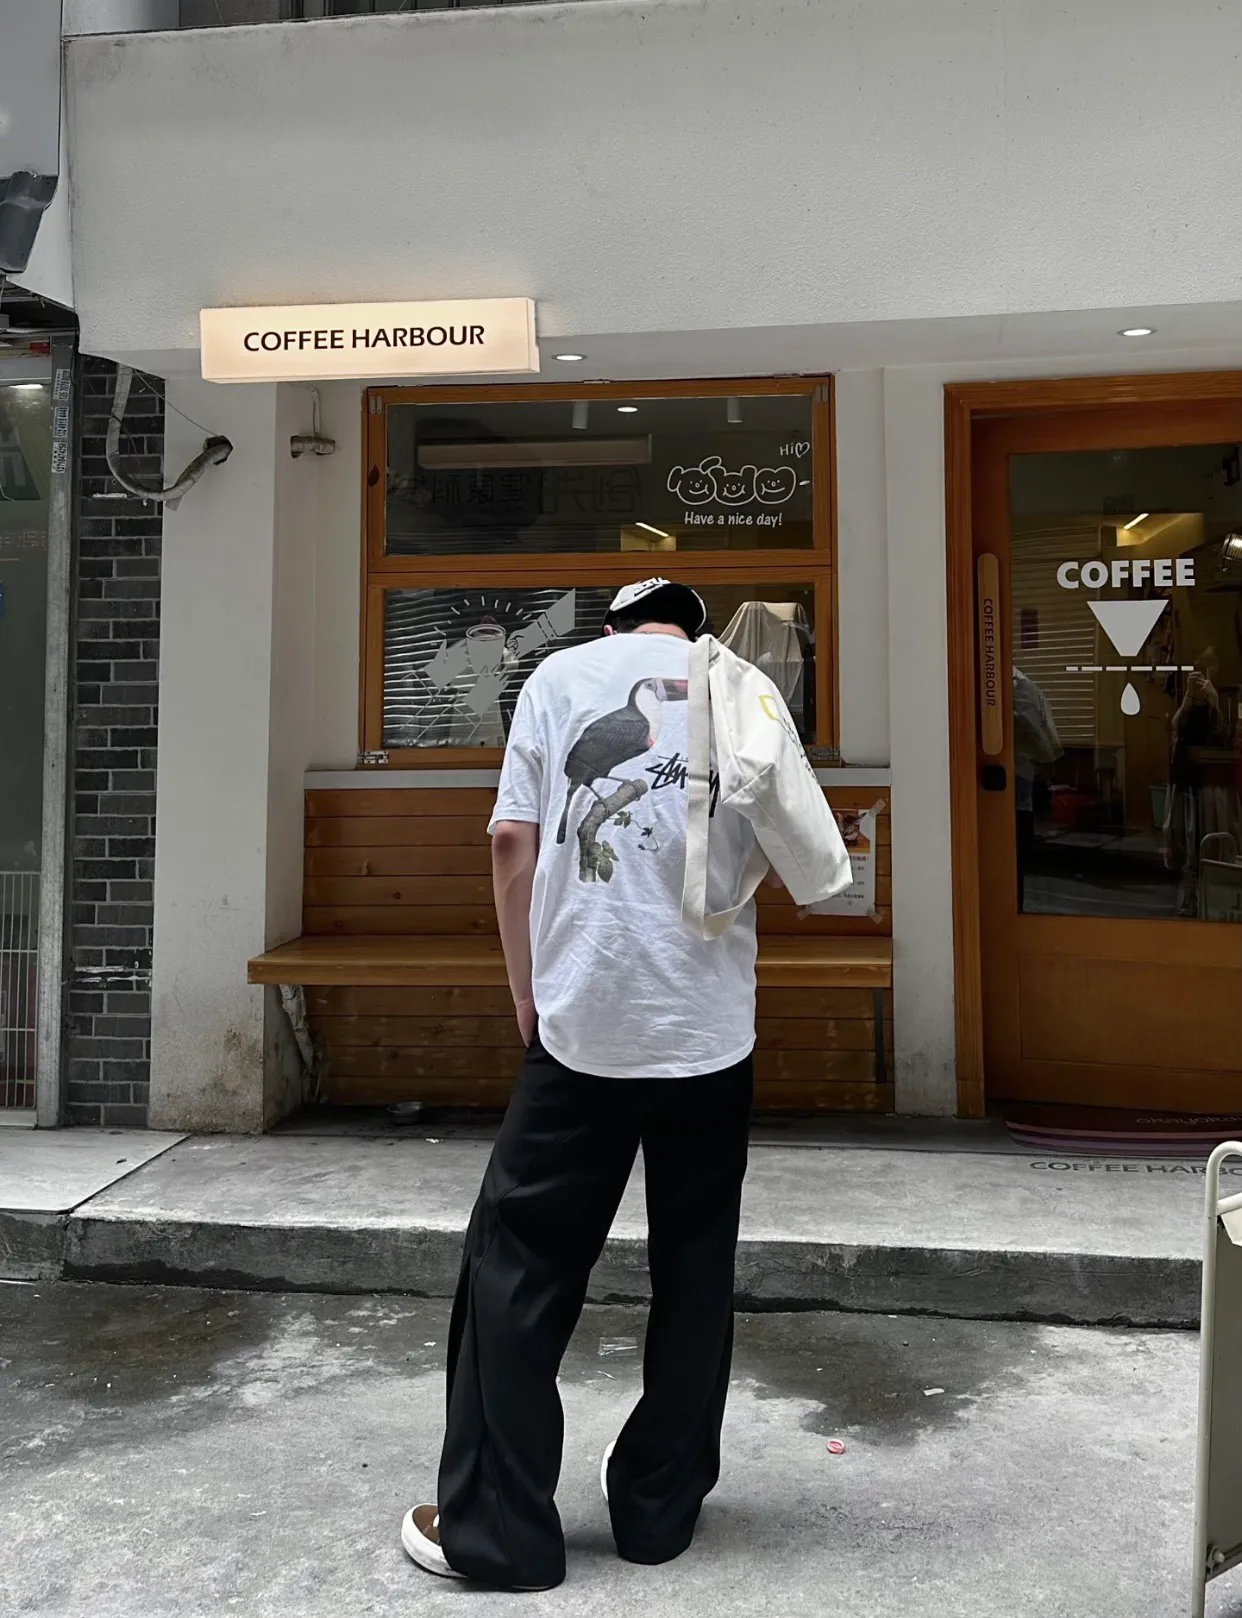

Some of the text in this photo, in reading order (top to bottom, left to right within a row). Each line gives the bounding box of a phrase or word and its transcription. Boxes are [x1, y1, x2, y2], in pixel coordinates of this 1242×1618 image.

[243, 325, 485, 351] COFFEE HARBOUR
[684, 511, 783, 528] Have a nice day!
[1056, 558, 1196, 589] COFFEE
[983, 598, 996, 707] COFFEE HARBOUR
[1029, 1161, 1139, 1173] COFFEE
